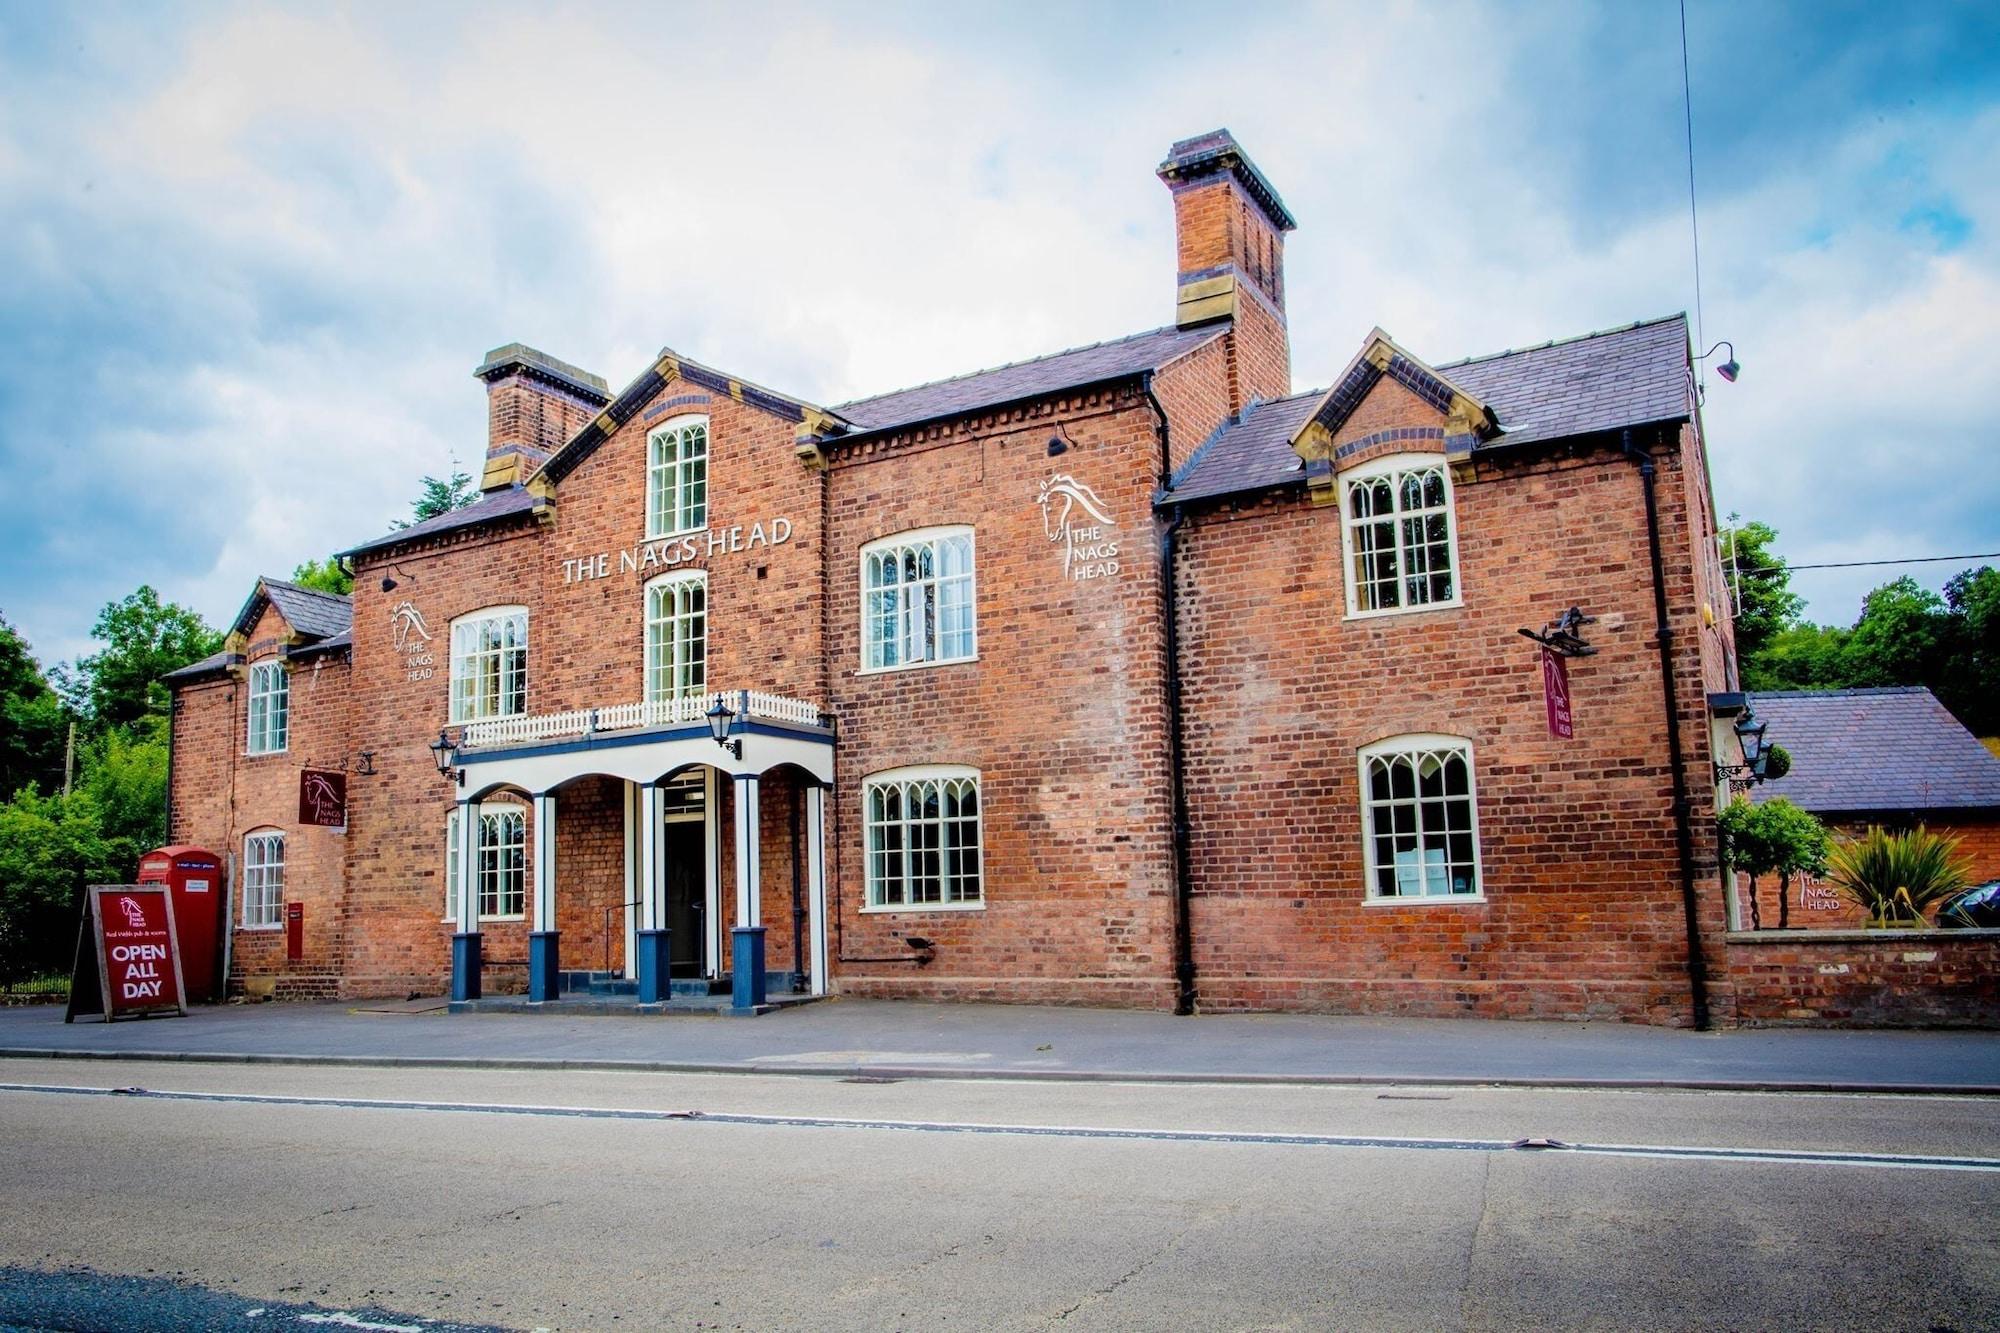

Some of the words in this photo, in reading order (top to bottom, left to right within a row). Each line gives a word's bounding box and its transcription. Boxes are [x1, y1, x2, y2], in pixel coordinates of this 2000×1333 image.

[1071, 526, 1102, 543] THE
[562, 554, 610, 584] THE
[620, 536, 697, 573] NAGS
[707, 517, 793, 557] HEAD
[1074, 543, 1118, 561] NAGS
[1075, 561, 1120, 580] HEAD
[408, 641, 425, 653] THE
[408, 654, 433, 668] NAGS
[408, 668, 433, 681] HEAD
[321, 801, 334, 809] THE
[320, 809, 341, 818] NAGS
[320, 817, 341, 825] HEAD
[1806, 887, 1839, 898] NAGS
[1807, 899, 1840, 910] HEAD
[112, 944, 167, 962] OPEN
[125, 962, 159, 979] ALL
[123, 980, 162, 999] DAY
